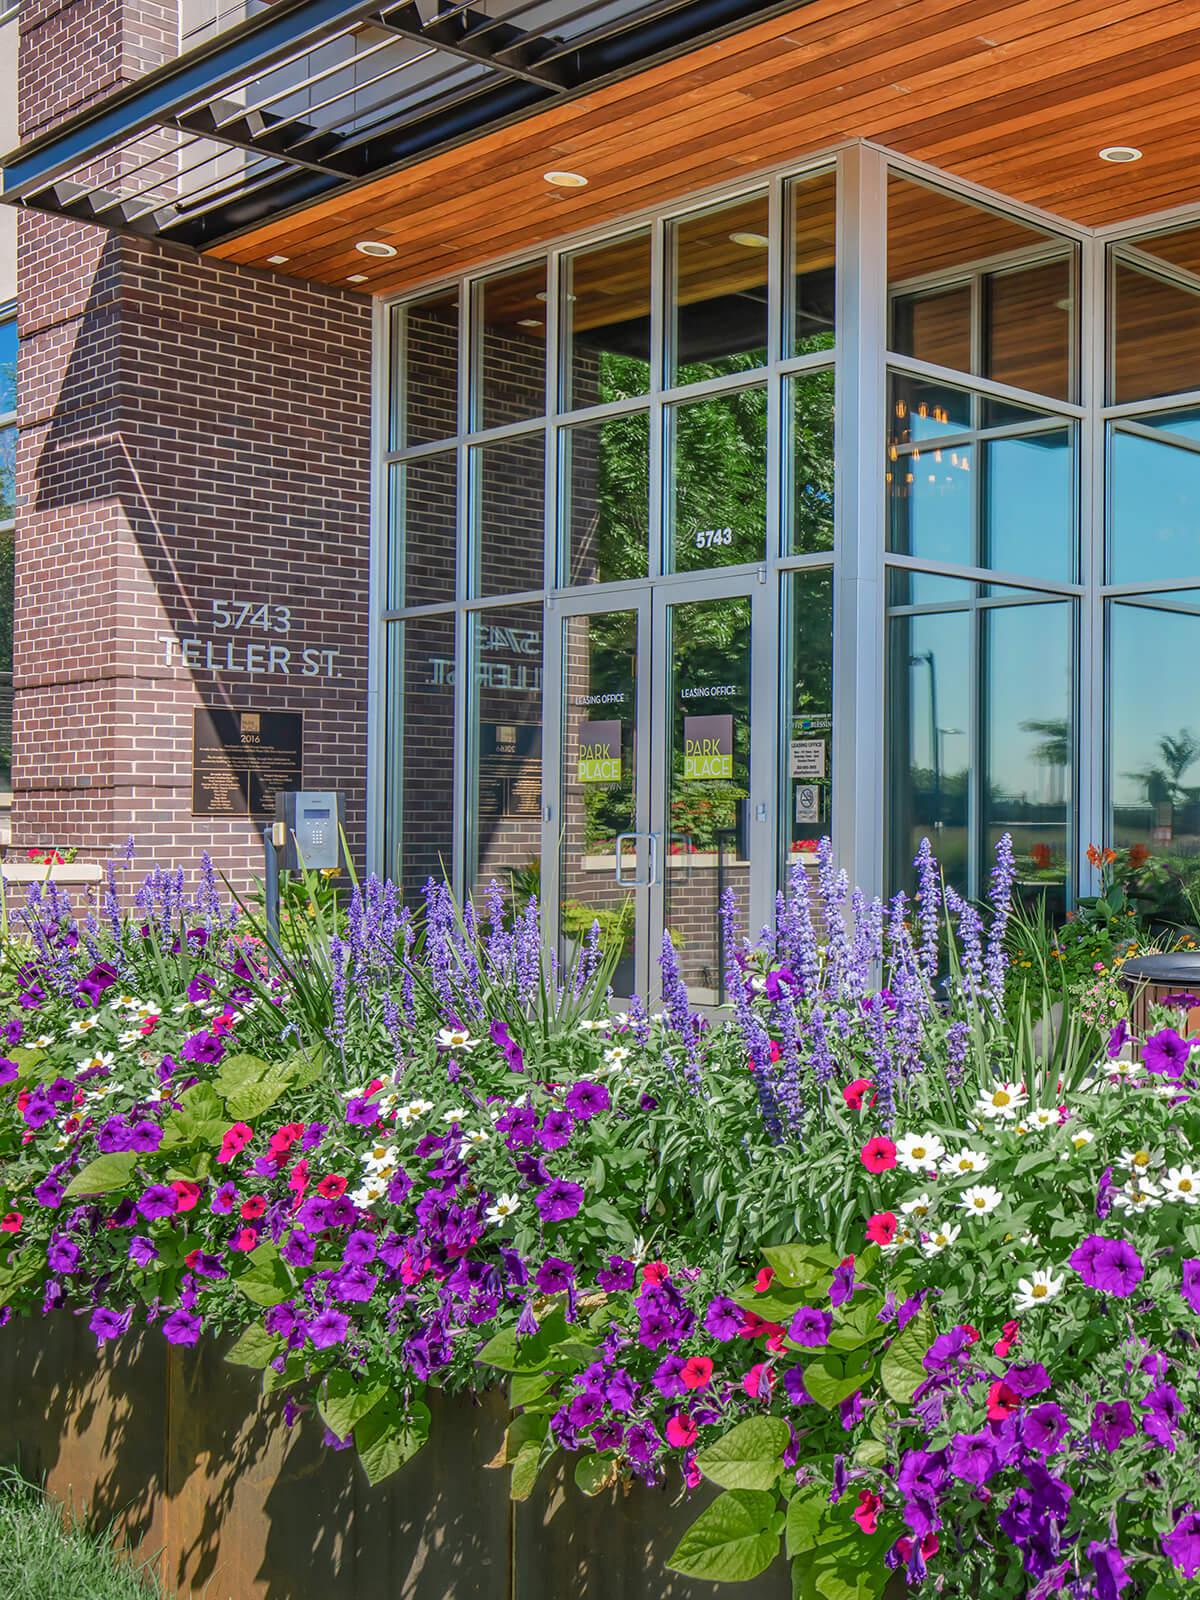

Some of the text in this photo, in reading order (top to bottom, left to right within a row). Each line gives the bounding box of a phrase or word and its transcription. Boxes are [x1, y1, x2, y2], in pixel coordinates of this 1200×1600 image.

[695, 526, 732, 549] 5743
[212, 599, 291, 633] 5743
[158, 636, 342, 678] TELLER ST.
[575, 693, 624, 706] LEASING OFFICE
[681, 685, 736, 698] LEASING OFFICE
[240, 734, 261, 744] 2016
[685, 738, 721, 757] PARK
[578, 743, 611, 760] PARK
[578, 760, 620, 780] PLACE
[685, 757, 730, 778] PLACE
